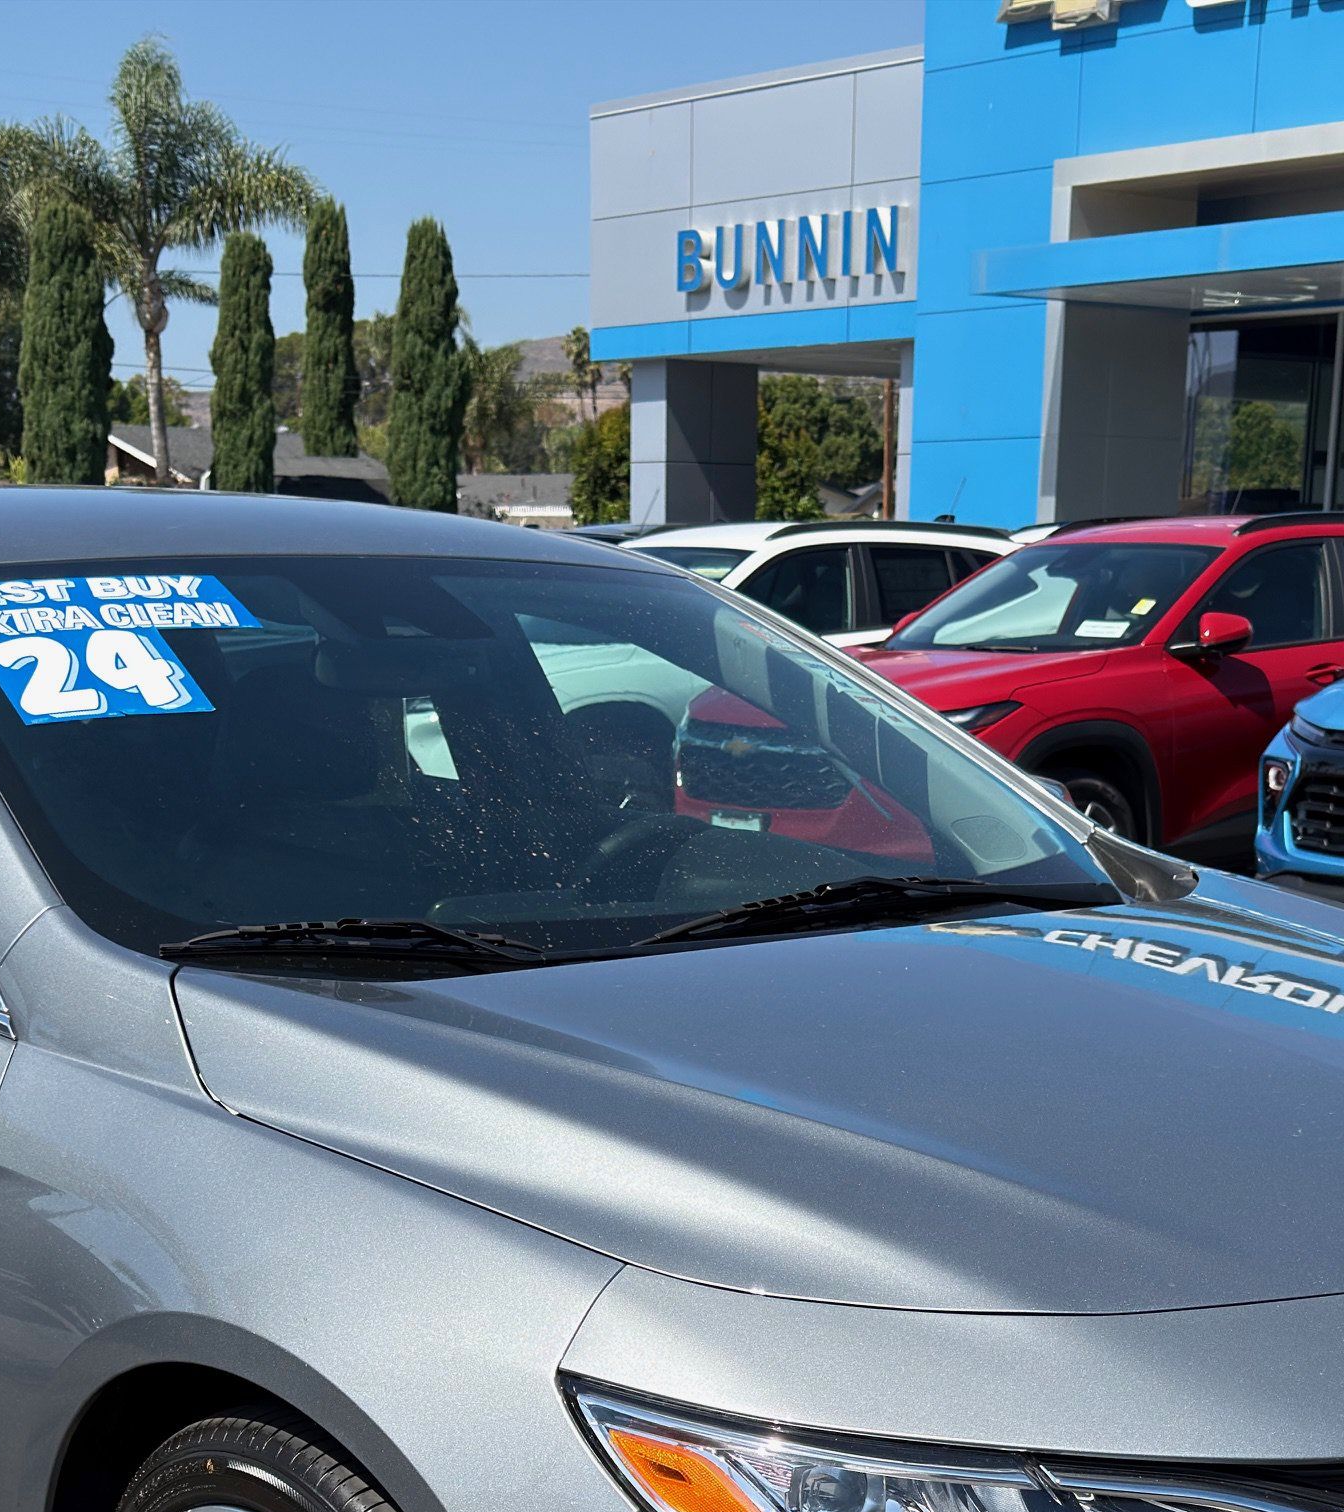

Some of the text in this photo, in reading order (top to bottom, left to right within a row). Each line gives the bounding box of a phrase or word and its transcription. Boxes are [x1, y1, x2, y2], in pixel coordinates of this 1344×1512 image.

[677, 205, 904, 293] BUNNIN
[85, 575, 203, 599] BUY
[99, 602, 239, 629] CLEAN
